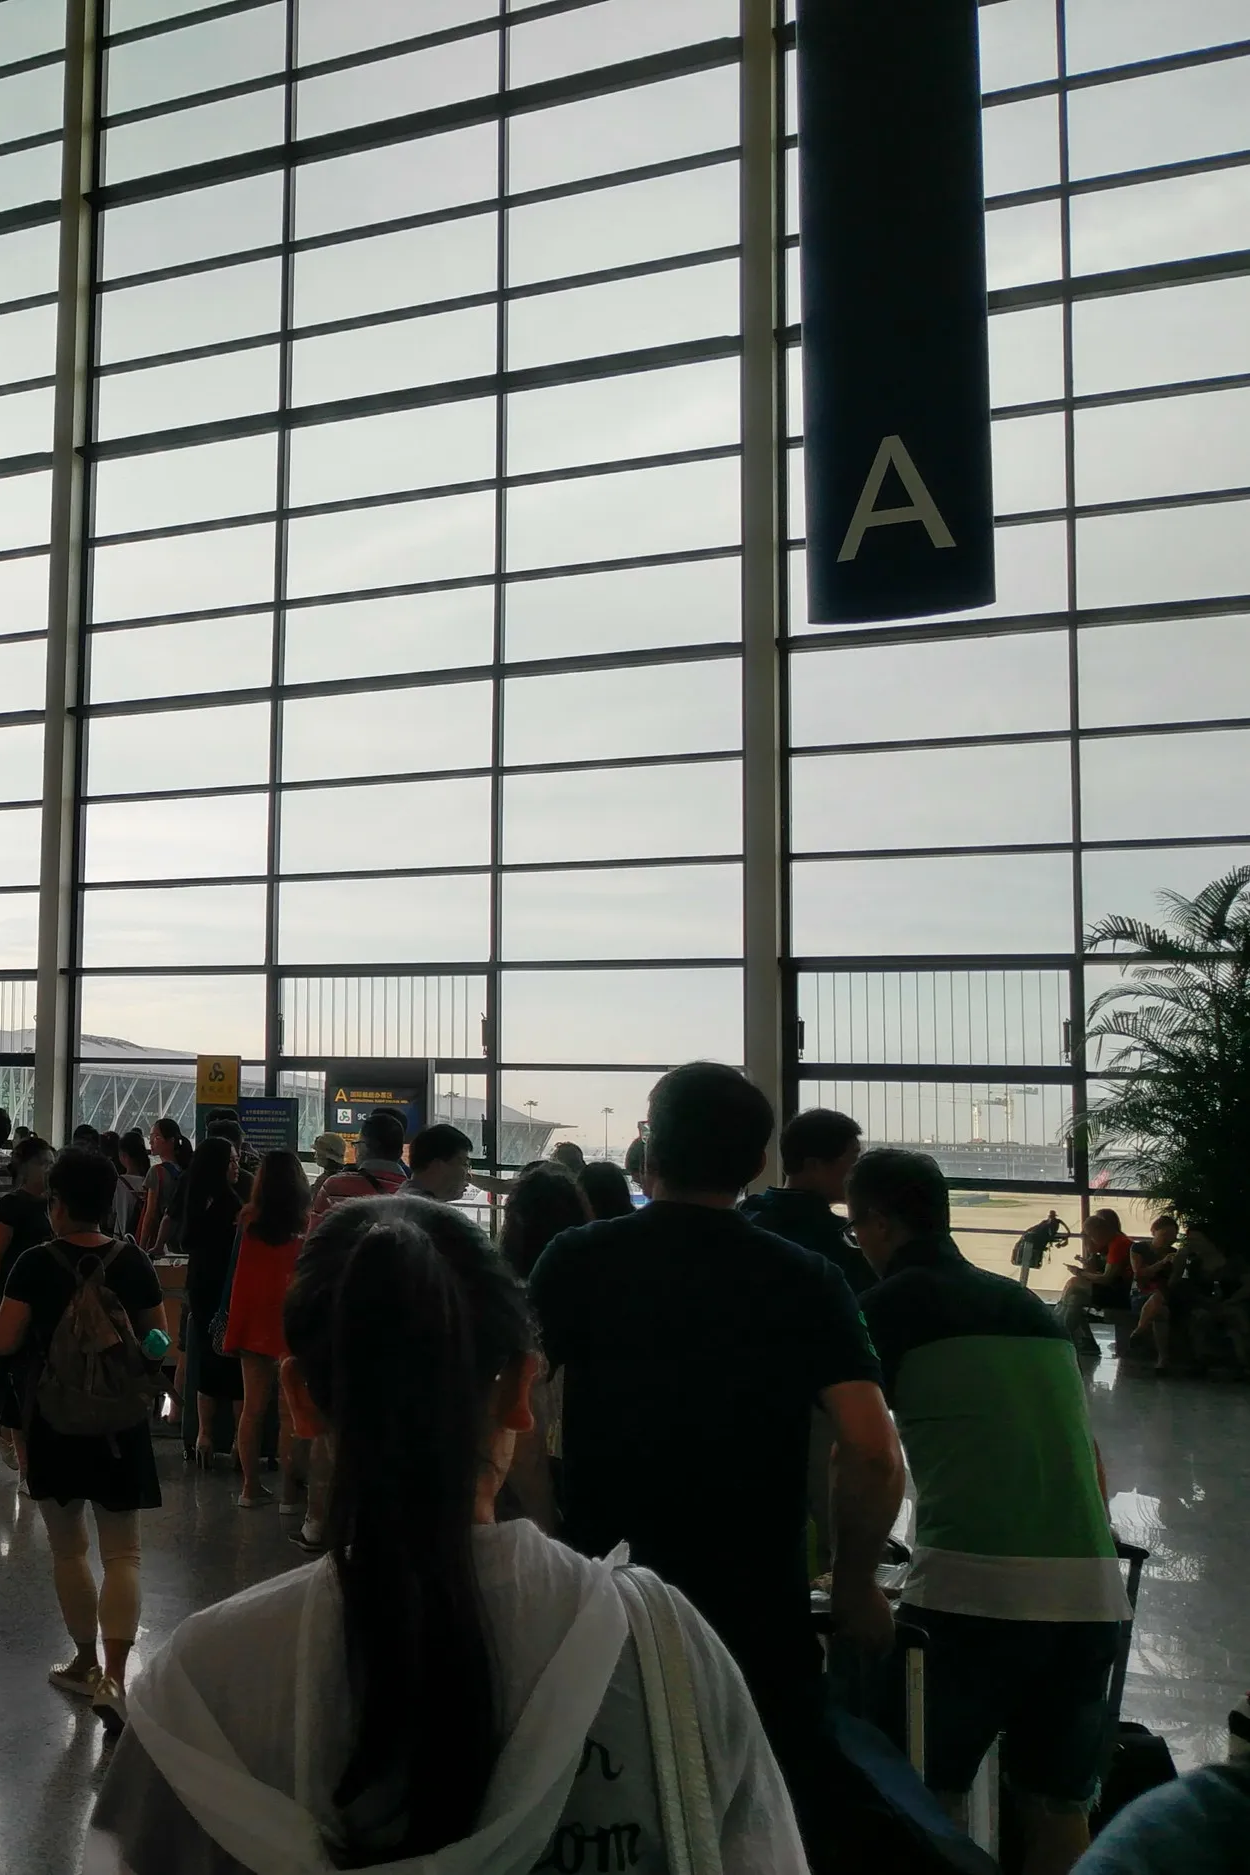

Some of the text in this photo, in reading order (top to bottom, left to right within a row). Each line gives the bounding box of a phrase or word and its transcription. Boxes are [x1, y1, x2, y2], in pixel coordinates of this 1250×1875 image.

[836, 435, 957, 563] A
[334, 1088, 348, 1102] A
[357, 1113, 367, 1121] 9C
[533, 1822, 643, 1875] om
